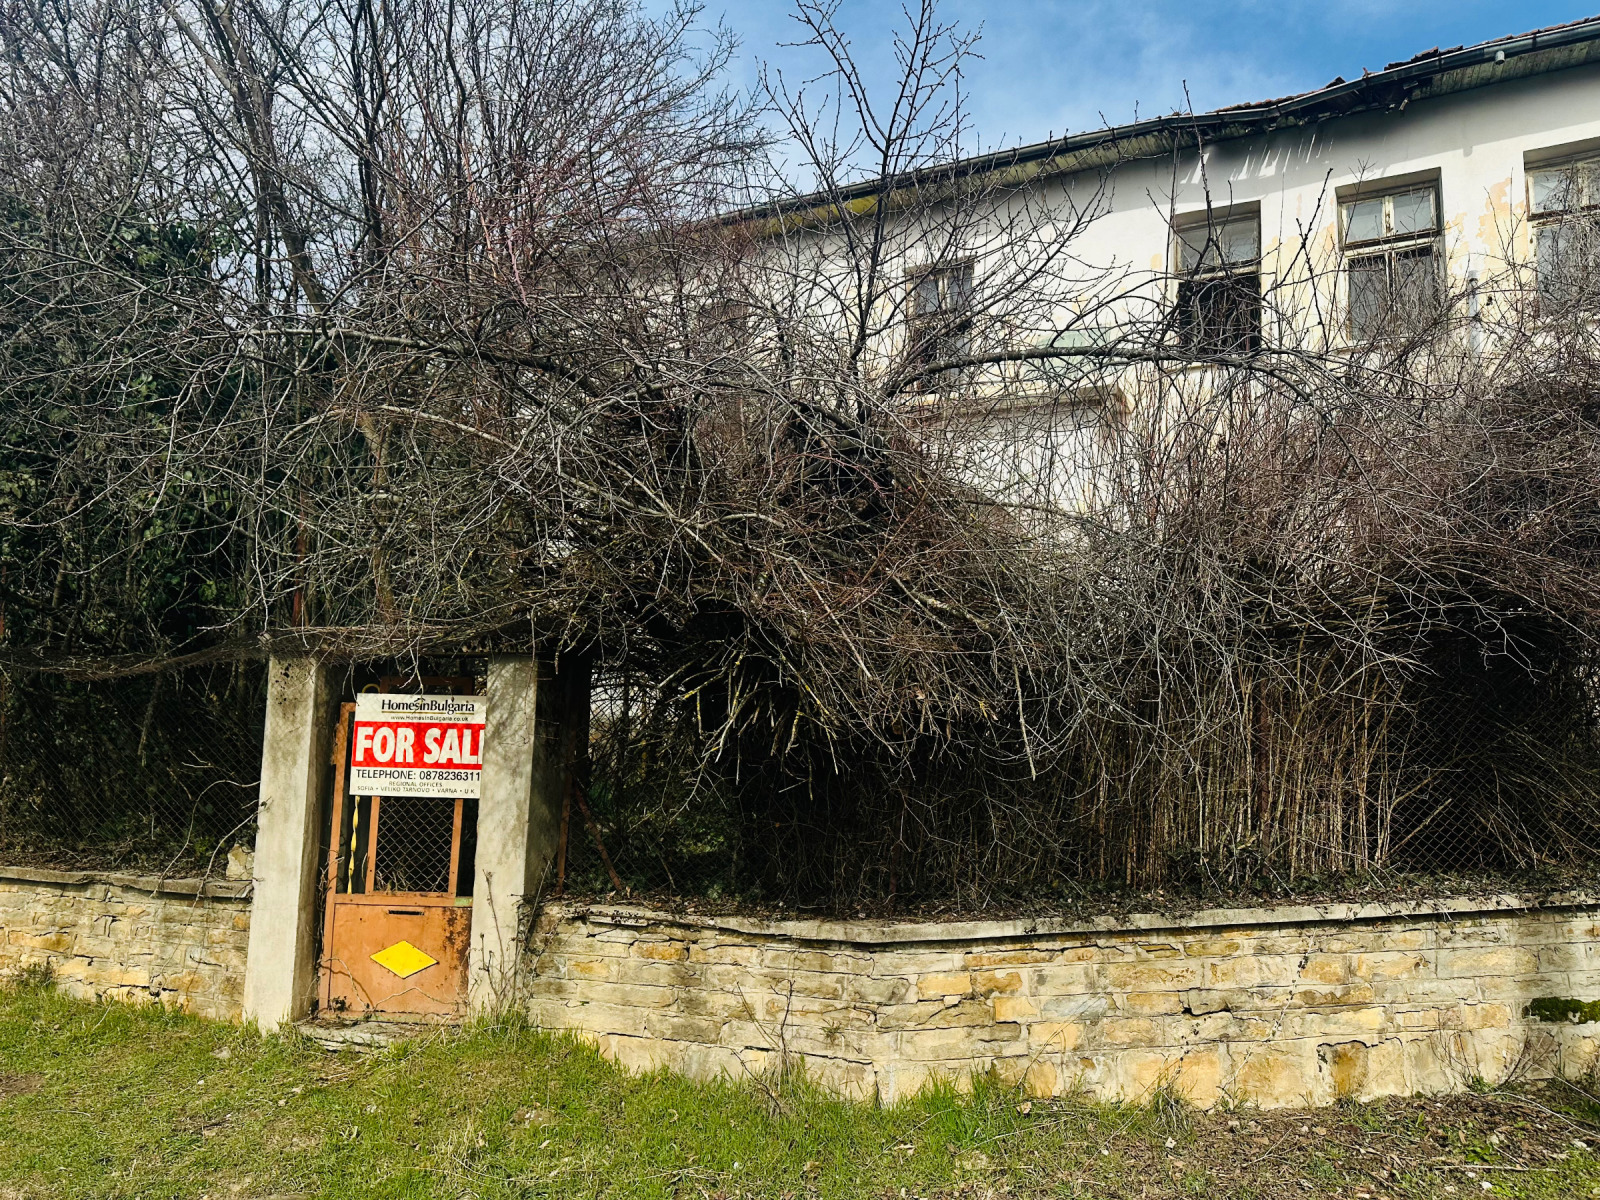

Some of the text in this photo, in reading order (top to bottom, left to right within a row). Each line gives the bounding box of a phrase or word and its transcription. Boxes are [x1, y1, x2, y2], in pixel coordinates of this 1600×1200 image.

[355, 726, 415, 763] FOR
[356, 769, 480, 781] TELEPHONE: 0878236311
